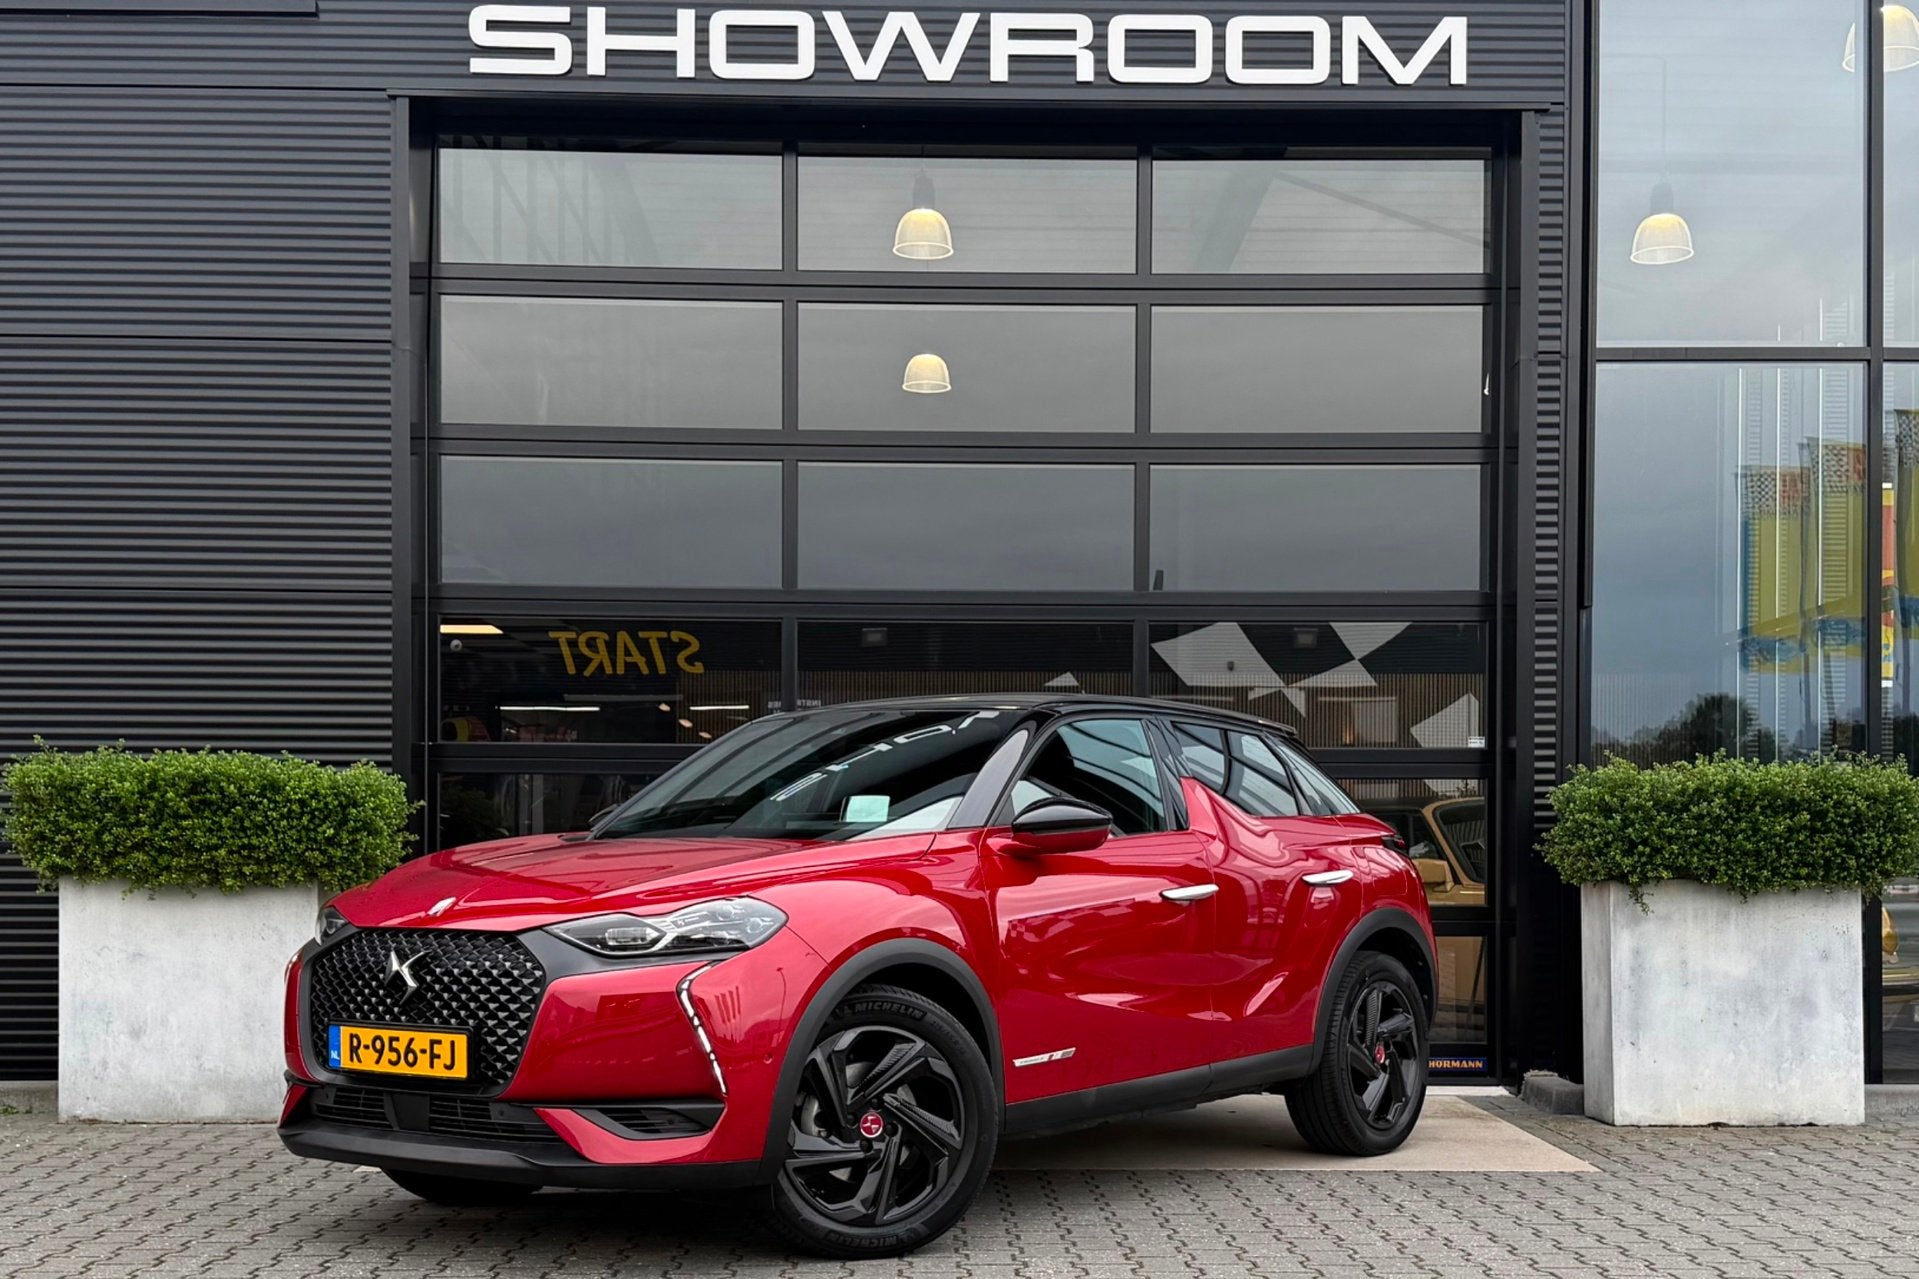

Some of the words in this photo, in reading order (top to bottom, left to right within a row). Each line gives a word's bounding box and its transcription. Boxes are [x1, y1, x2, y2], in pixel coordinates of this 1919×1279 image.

[468, 4, 1468, 85] SHOWROOM
[855, 1002, 924, 1019] MICHELIN
[331, 1050, 340, 1060] NL
[349, 1032, 456, 1071] R-956-FJ
